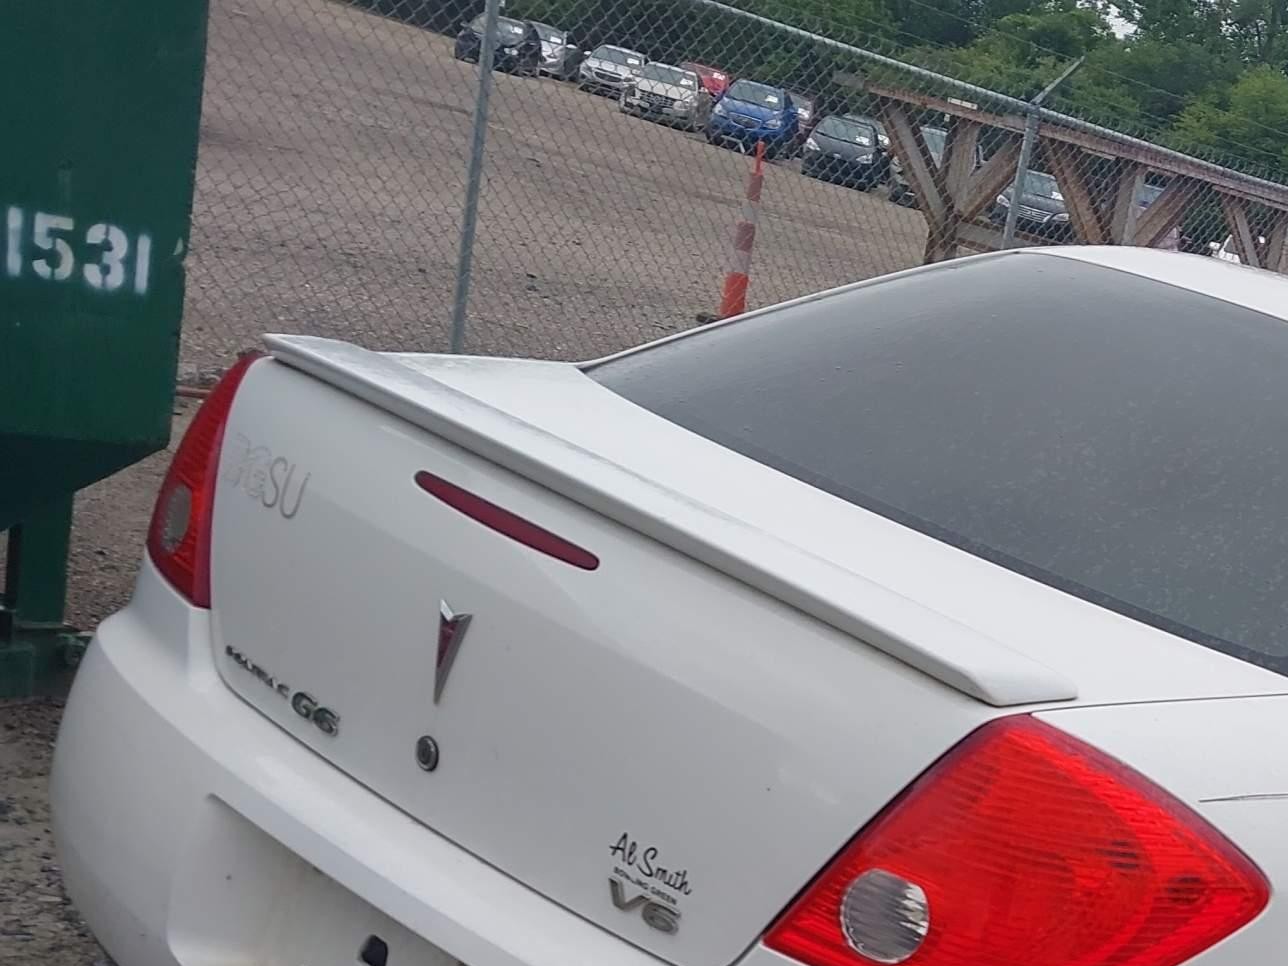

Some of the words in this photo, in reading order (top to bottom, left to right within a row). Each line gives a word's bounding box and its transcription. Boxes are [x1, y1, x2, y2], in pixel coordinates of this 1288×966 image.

[7, 206, 151, 295] 1531
[291, 692, 340, 737] G6
[609, 832, 637, 866] Al
[637, 847, 692, 896] Smith
[608, 877, 681, 936] V6
